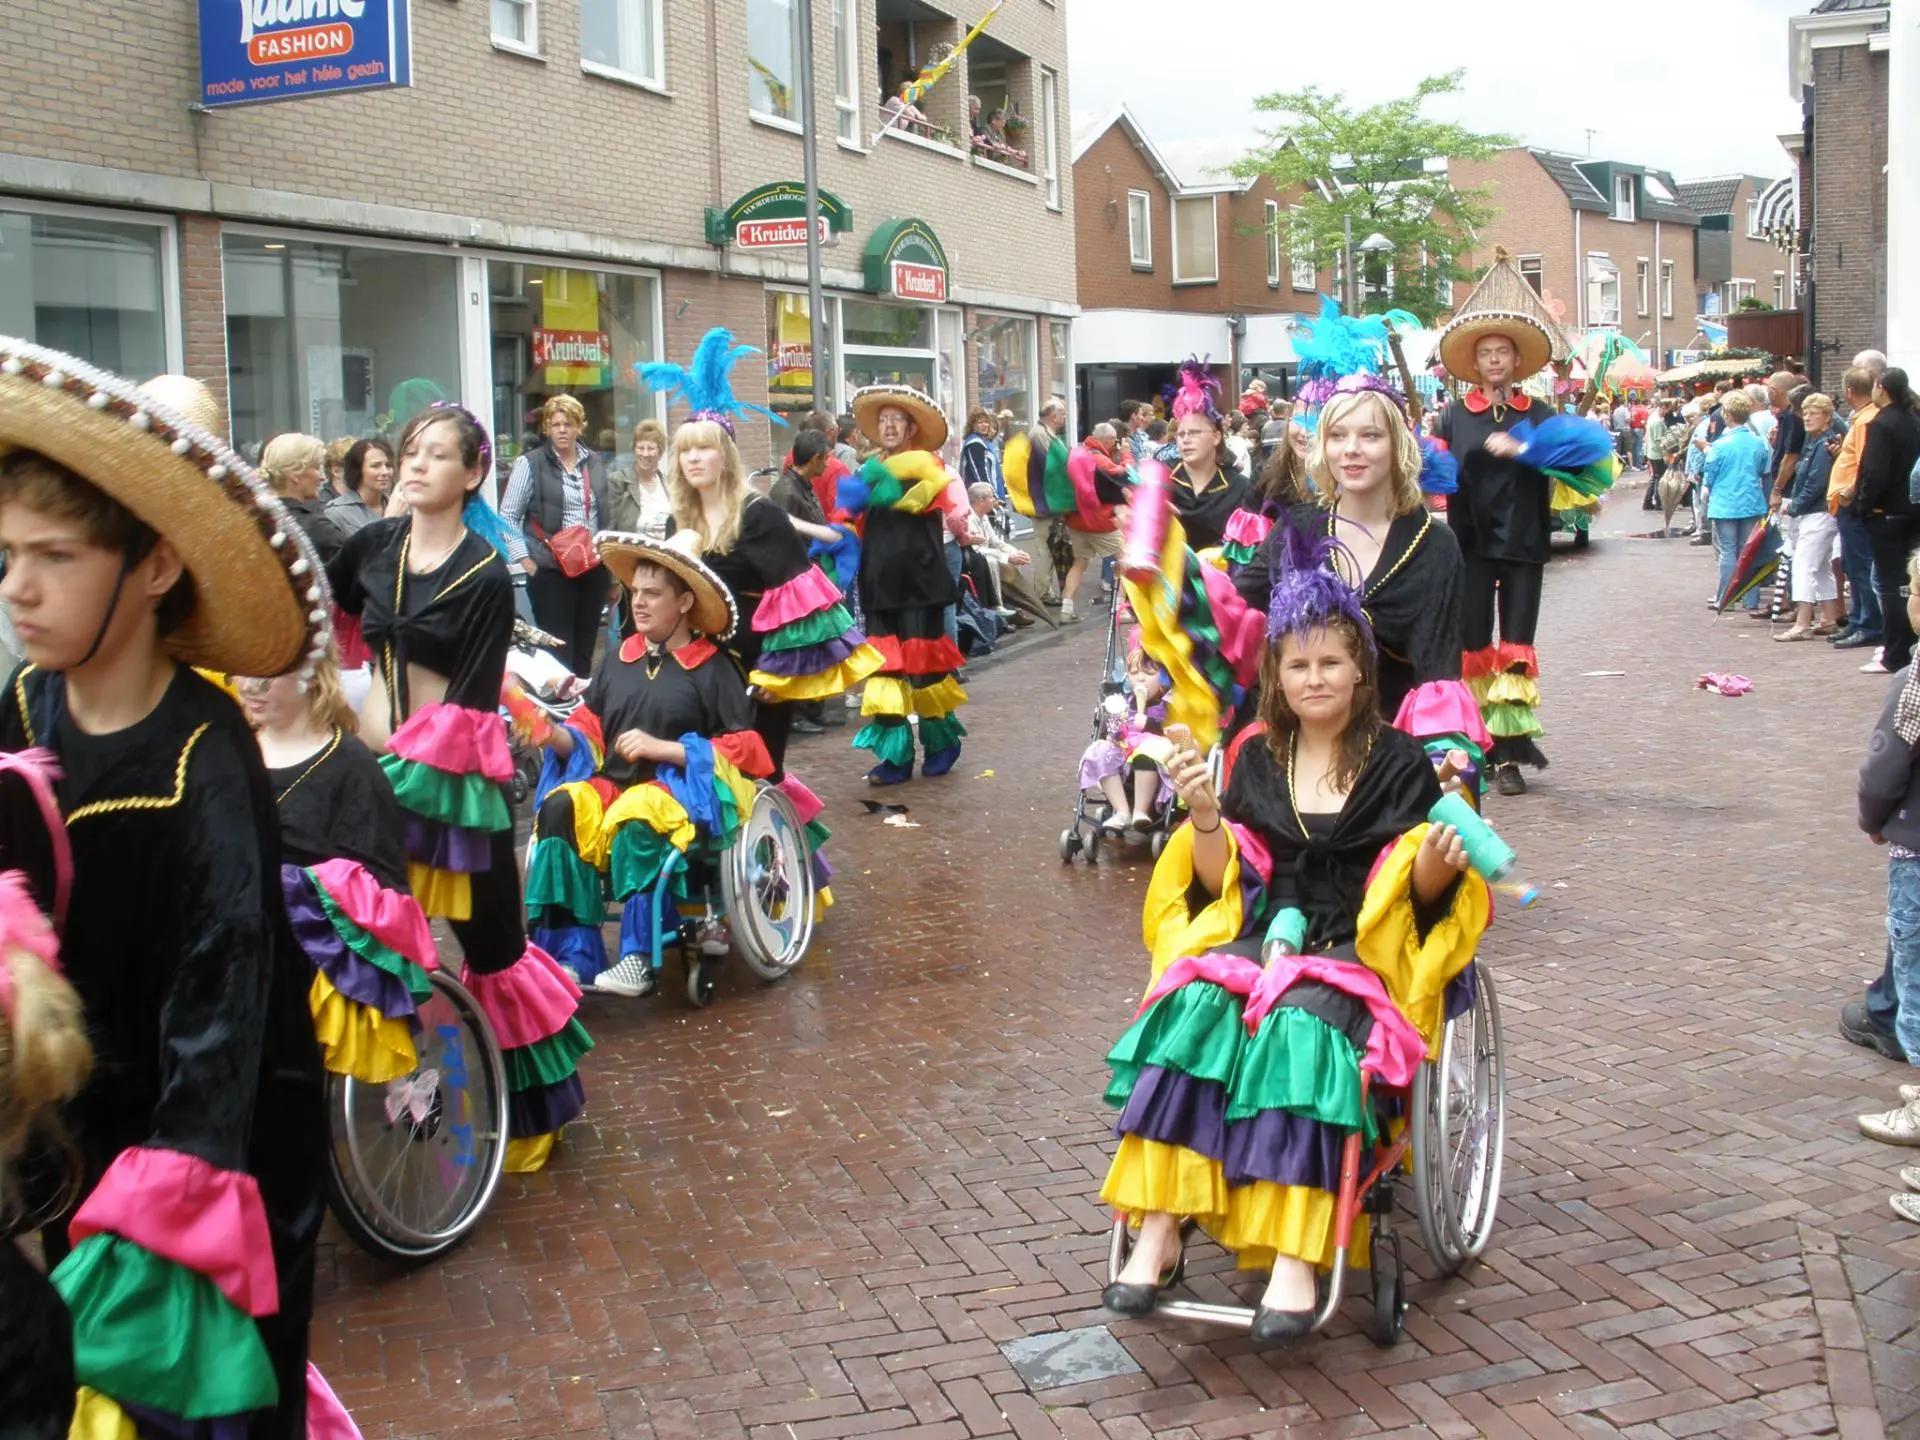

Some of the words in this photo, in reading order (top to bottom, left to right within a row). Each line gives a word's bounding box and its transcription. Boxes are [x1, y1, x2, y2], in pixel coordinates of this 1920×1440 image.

[258, 30, 344, 57] FASHION
[207, 78, 245, 96] mode
[250, 75, 280, 90] voor
[284, 71, 307, 86] het
[347, 60, 385, 80] gezin
[750, 224, 809, 242] Kruidva
[905, 269, 936, 294] Kruidvat
[543, 334, 601, 361] Kruidvat
